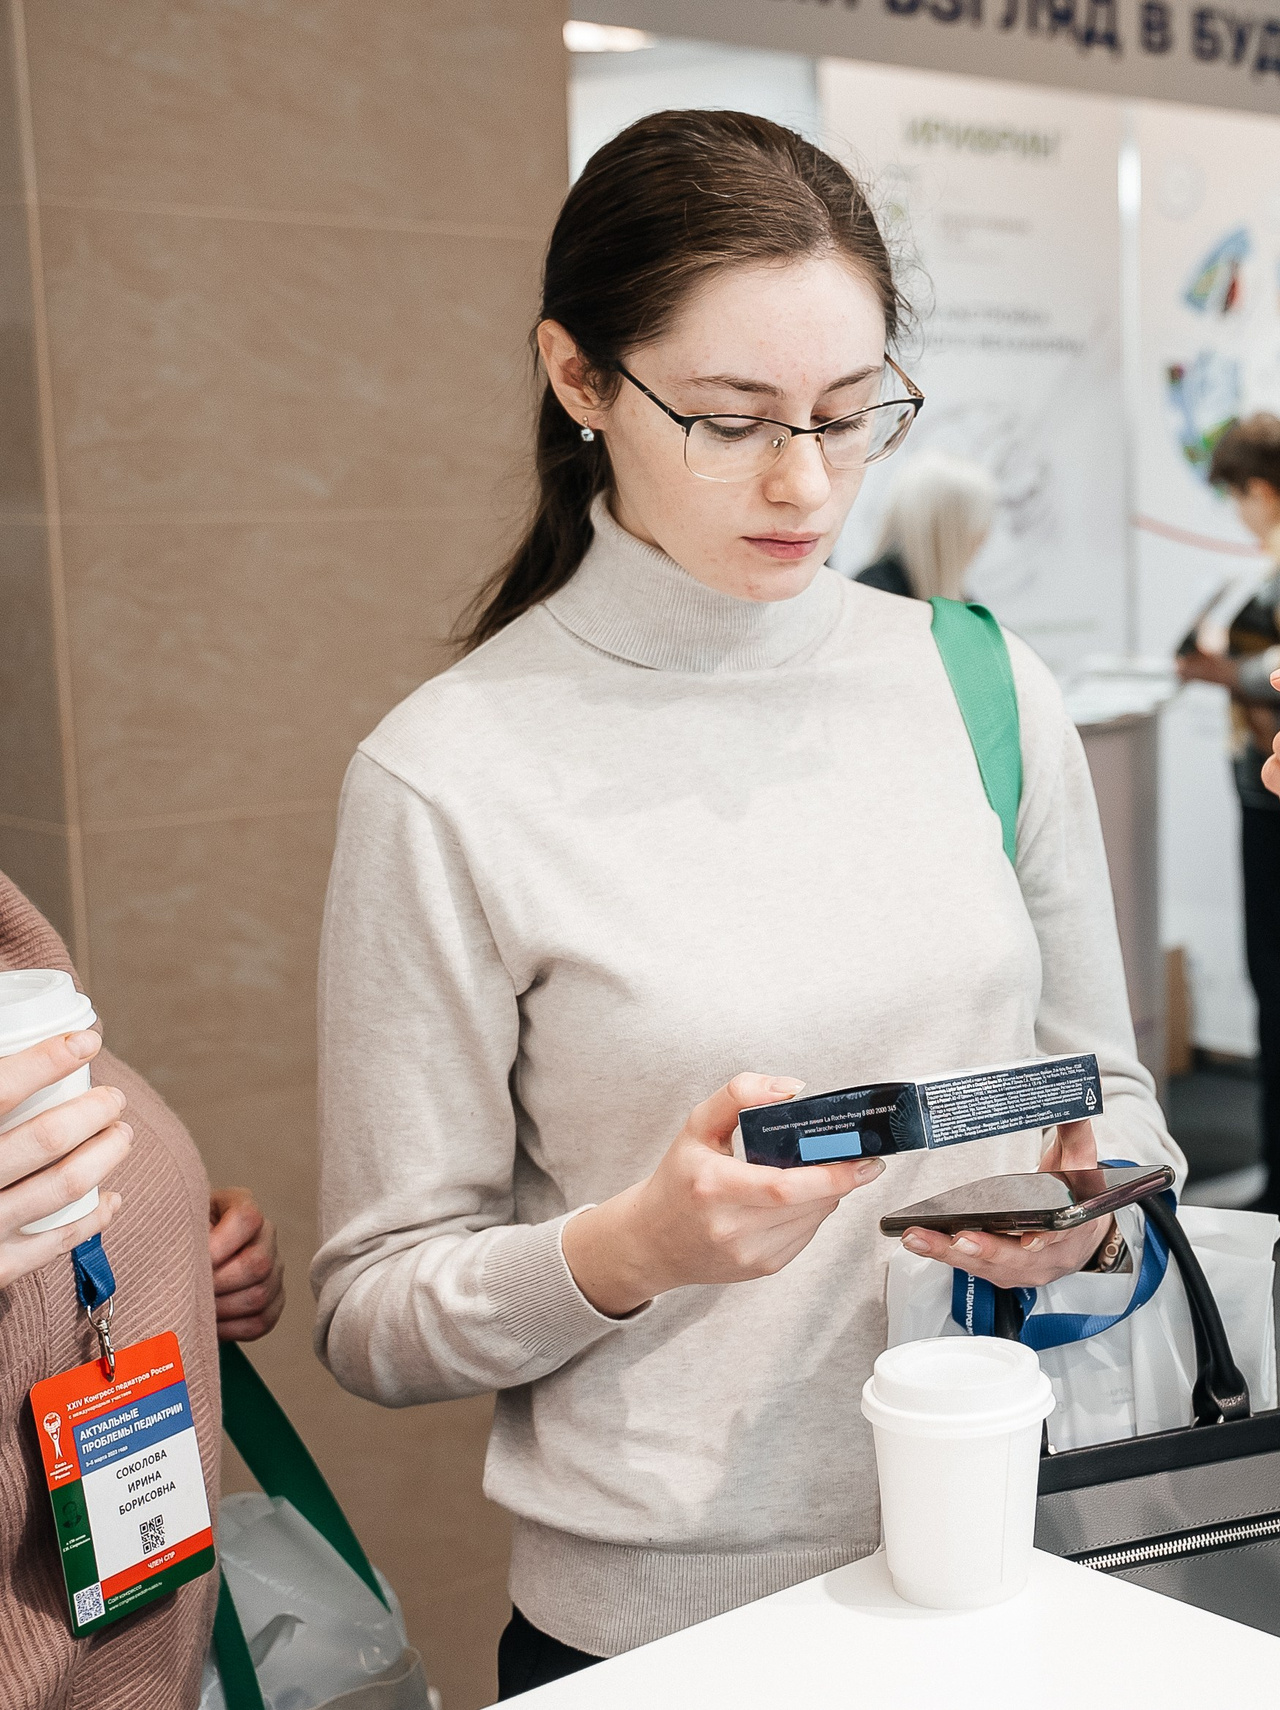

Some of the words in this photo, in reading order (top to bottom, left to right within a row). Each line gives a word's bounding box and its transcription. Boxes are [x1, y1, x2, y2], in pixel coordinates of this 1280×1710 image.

[1140, 2, 1172, 54] В
[831, 1111, 861, 1121] Roche-Posay
[866, 1107, 875, 1116] 800
[875, 1106, 887, 1114] 2000
[66, 1399, 83, 1412] XXIV
[84, 1388, 115, 1405] Конгресс
[116, 1373, 150, 1391] педиатров
[151, 1363, 174, 1375] России
[80, 1407, 140, 1441] АКТУАЛЬНЫЕ
[81, 1424, 134, 1455] ПРОБЛЕМЫ
[134, 1402, 183, 1432] ПЕДИАТРИИ
[116, 1449, 168, 1480] СОКОЛОВА
[127, 1470, 162, 1493] ИРИНА
[119, 1480, 176, 1516] БОРИСОВНА
